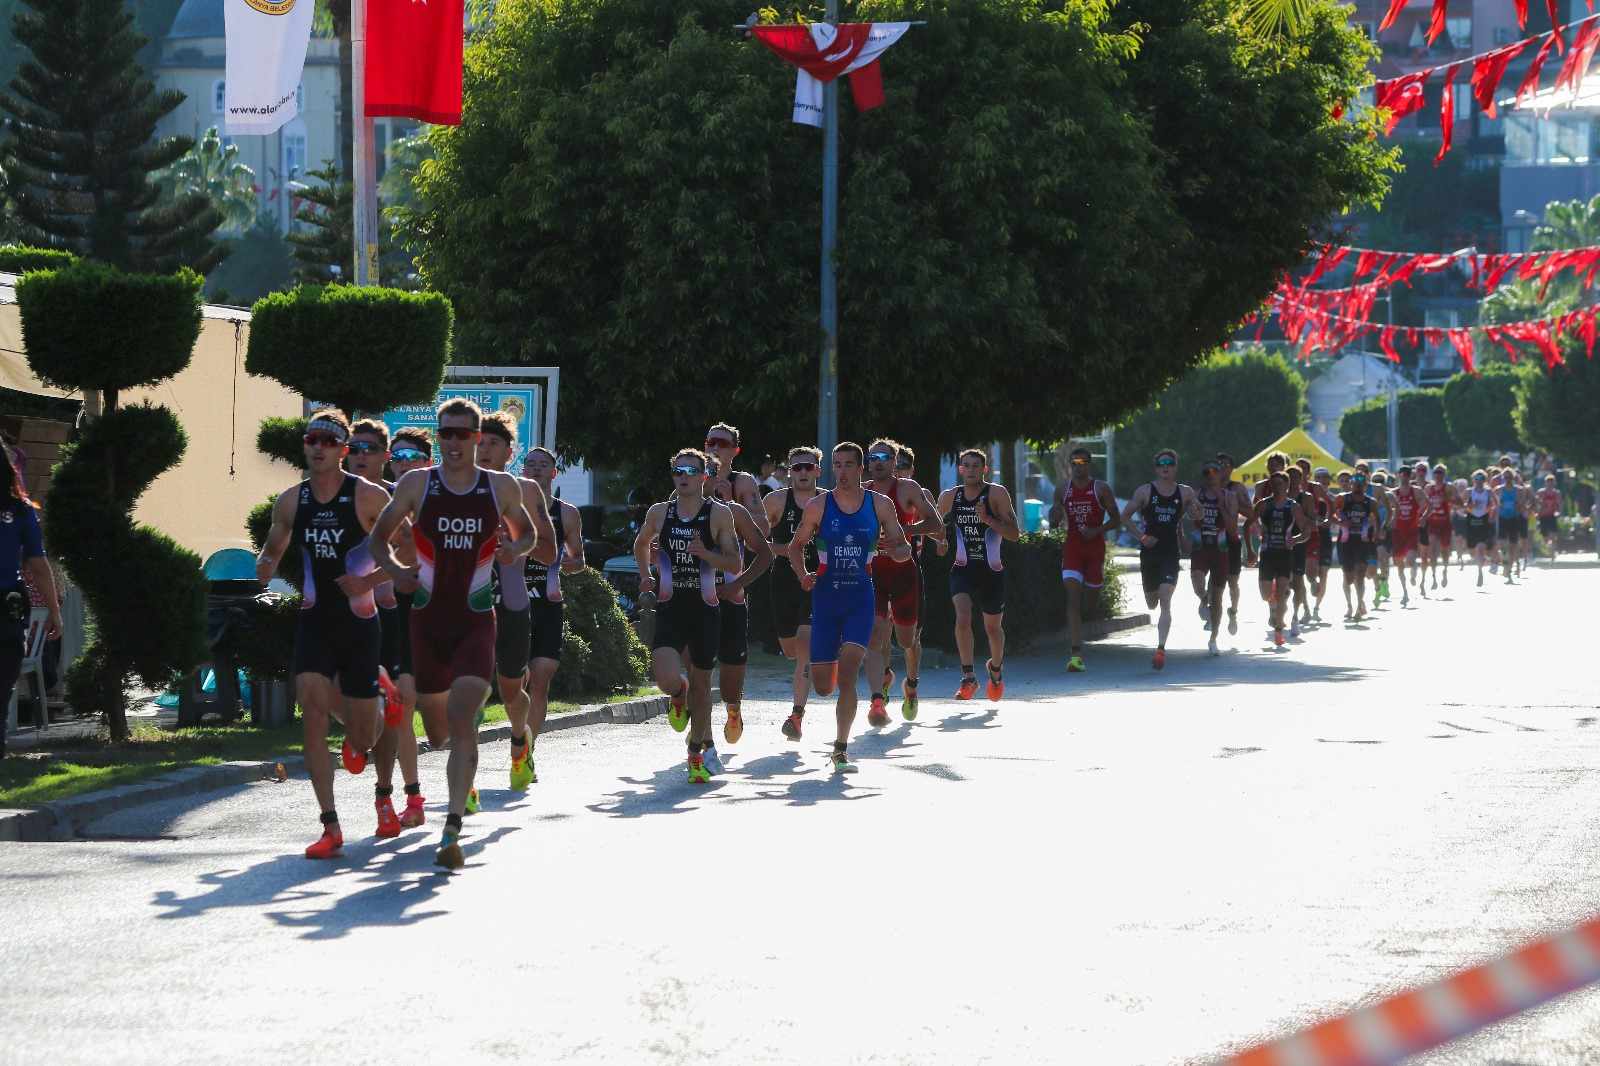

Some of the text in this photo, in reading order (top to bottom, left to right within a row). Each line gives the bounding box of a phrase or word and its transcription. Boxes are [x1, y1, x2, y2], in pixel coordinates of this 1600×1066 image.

[436, 516, 484, 534] DOBI
[965, 526, 980, 537] FRA
[303, 528, 345, 544] HAY
[442, 534, 474, 551] HUN
[314, 543, 338, 560] FRA
[676, 552, 694, 565] FRA
[835, 558, 860, 569] ITA
